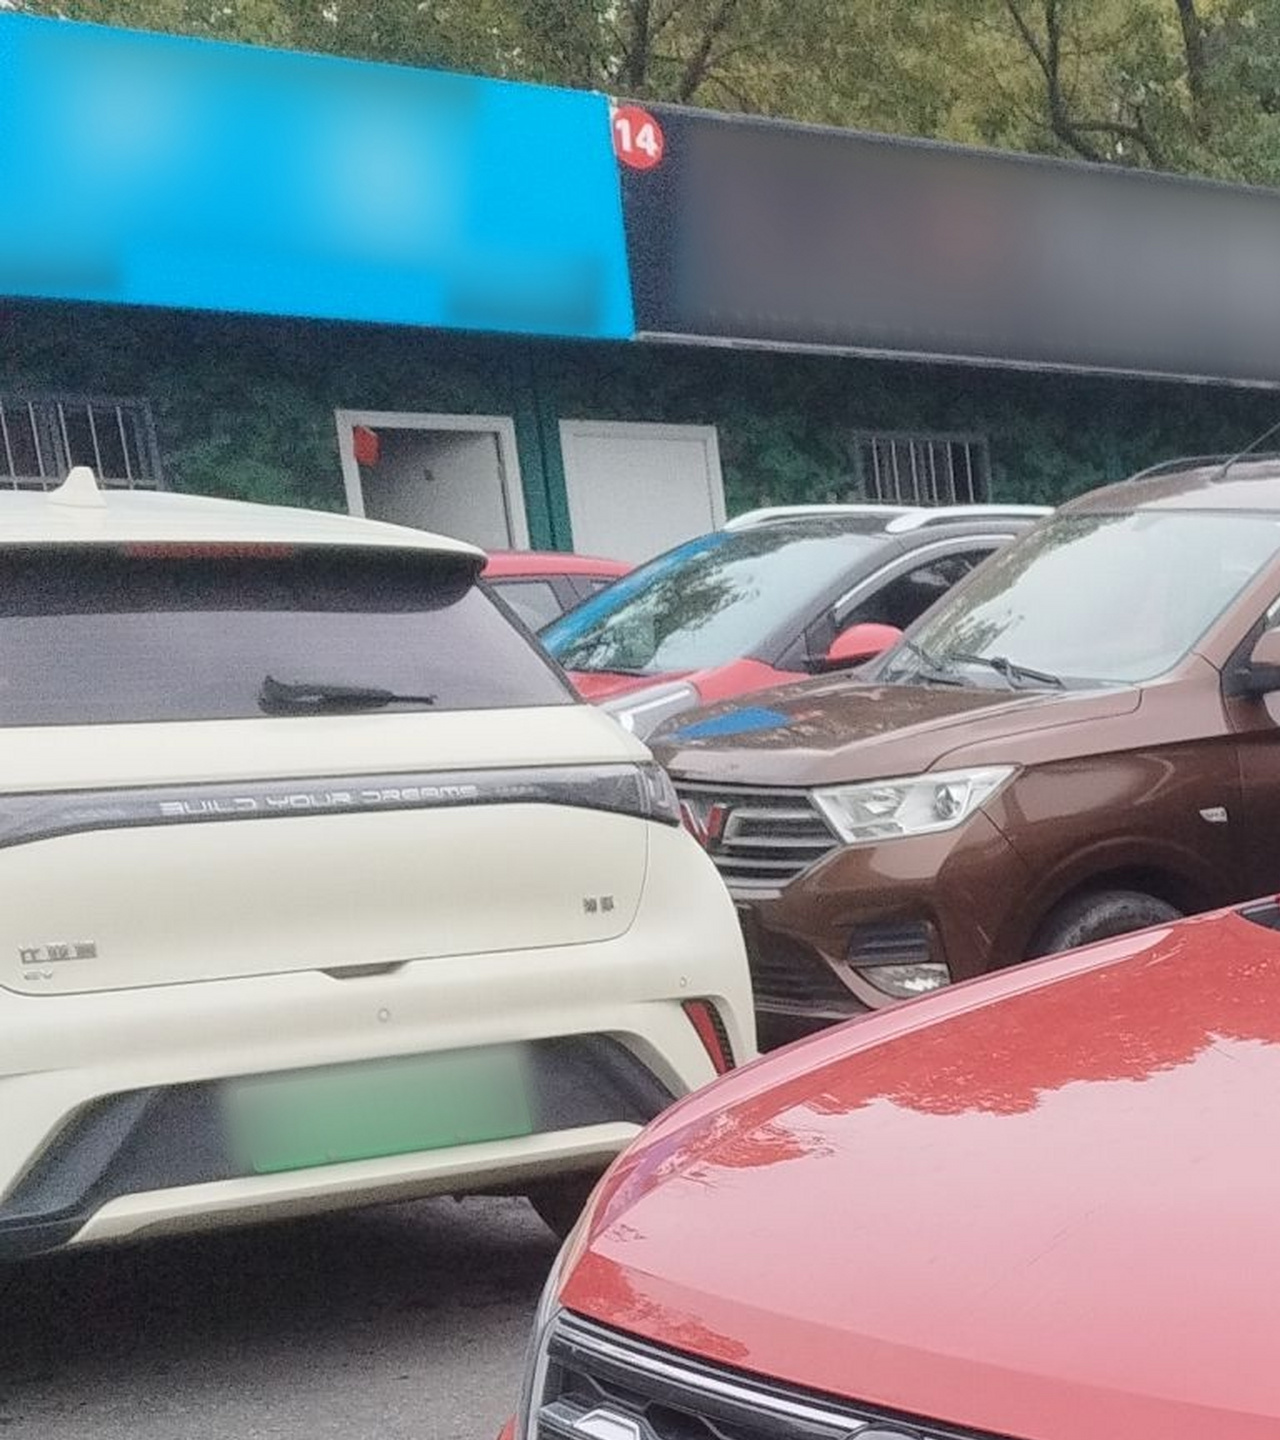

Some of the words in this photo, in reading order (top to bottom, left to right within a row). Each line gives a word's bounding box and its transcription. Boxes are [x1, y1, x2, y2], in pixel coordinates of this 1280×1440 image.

[615, 118, 658, 157] 14
[159, 798, 257, 817] BUILD
[266, 791, 350, 809] YOUR
[361, 784, 479, 802] DREAMS
